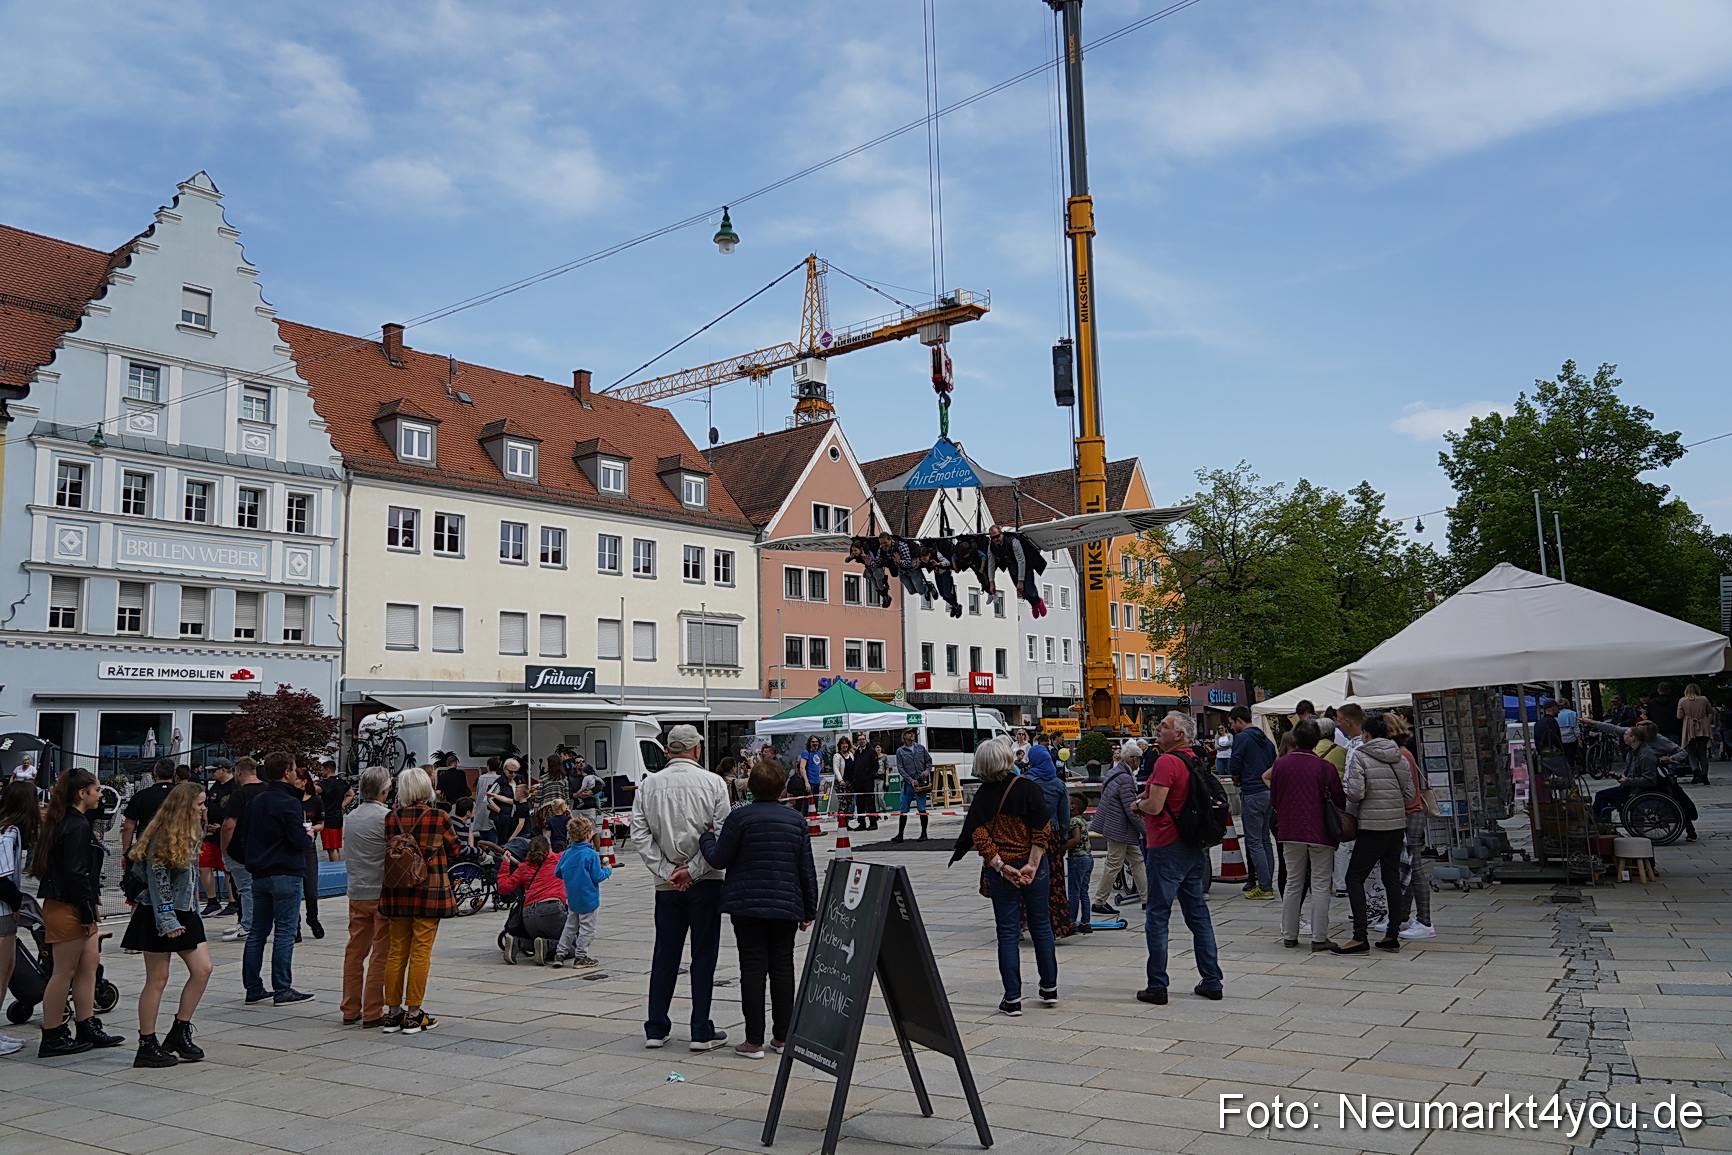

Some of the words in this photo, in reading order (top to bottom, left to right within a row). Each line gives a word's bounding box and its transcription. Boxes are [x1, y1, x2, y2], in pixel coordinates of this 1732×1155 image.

[1079, 270, 1089, 323] MIKSCHL
[837, 332, 872, 347] LIEBHERR
[909, 467, 971, 486] AirEmotion
[126, 539, 195, 561] BRILLEN
[199, 546, 259, 567] WEBER
[1086, 495, 1104, 591] MIKSL
[107, 665, 155, 677] RÄTZER
[158, 668, 225, 679] IMMOBILIEN
[975, 675, 993, 686] WITT
[813, 953, 840, 979] Spenden
[840, 973, 851, 985] an
[807, 981, 854, 1018] UKRAINE
